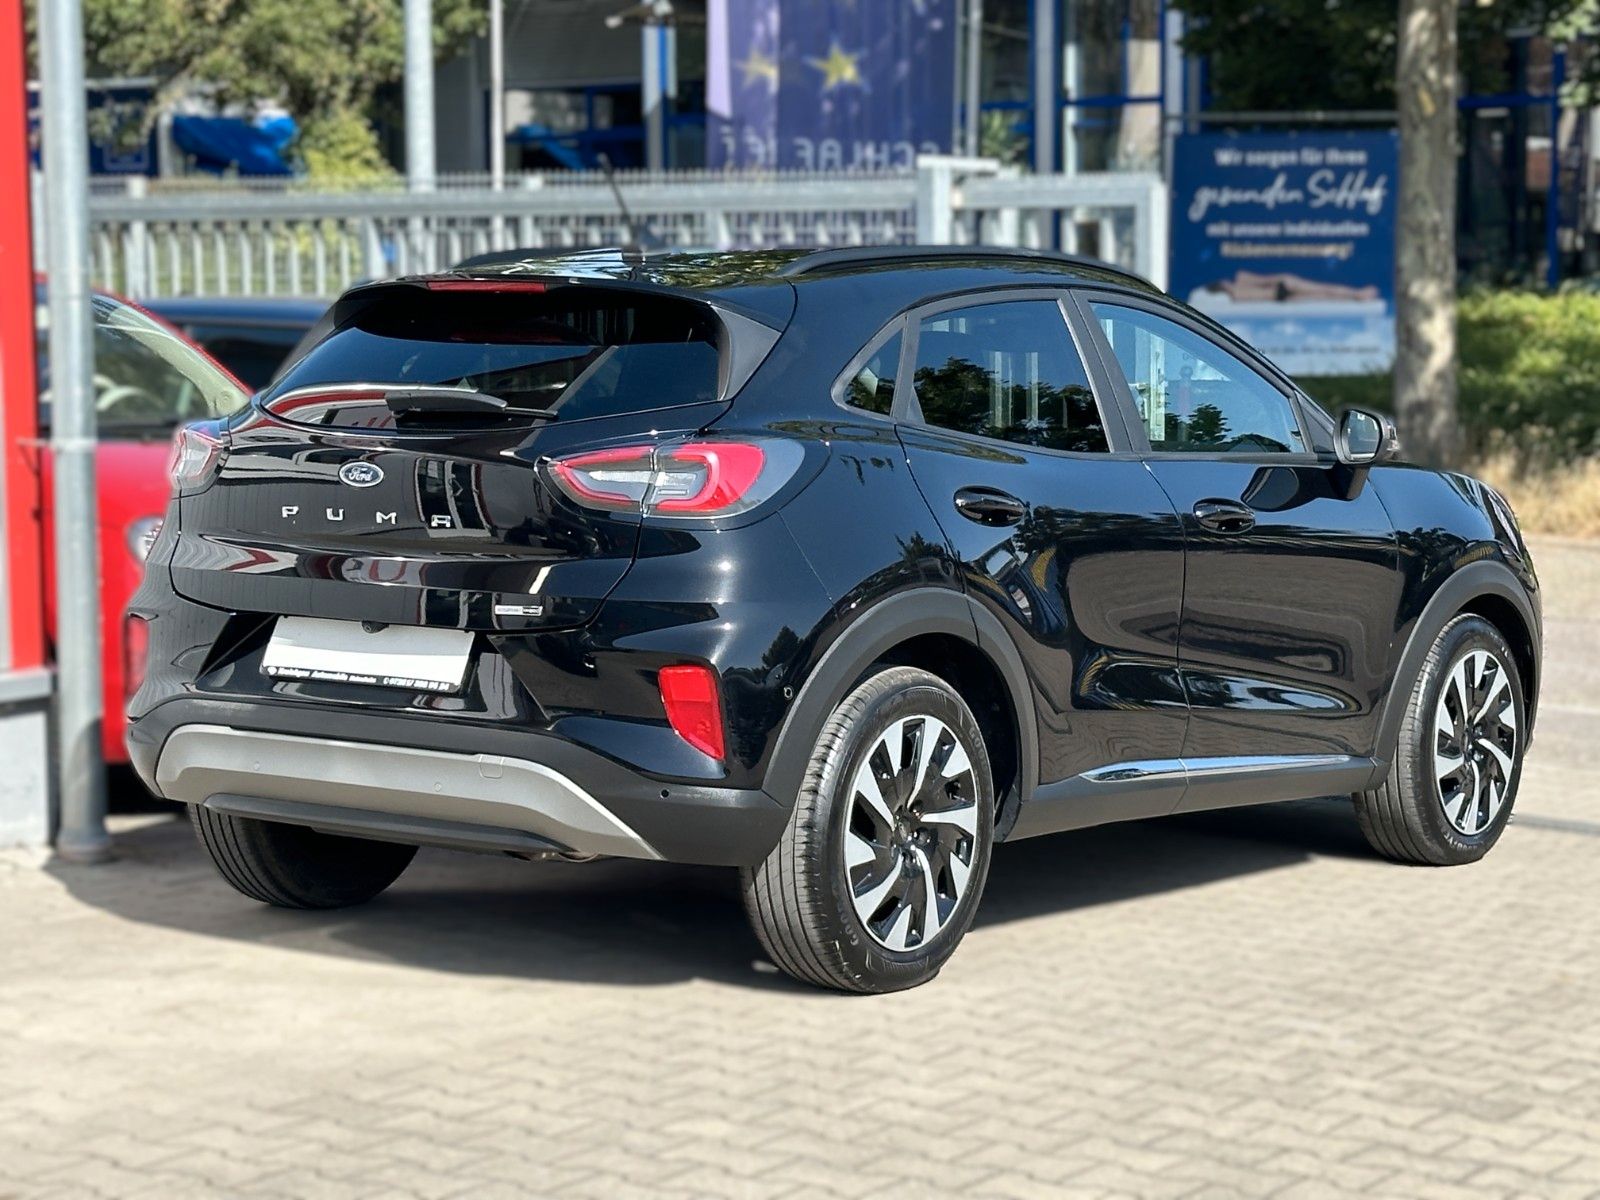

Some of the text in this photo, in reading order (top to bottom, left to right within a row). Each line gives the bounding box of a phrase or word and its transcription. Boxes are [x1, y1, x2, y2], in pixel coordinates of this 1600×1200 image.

[1214, 147, 1368, 169] Wir sorgen für Ihren
[1188, 168, 1388, 221] gesunden Schlaf
[346, 465, 374, 482] Ford
[282, 505, 451, 528] PUMA
